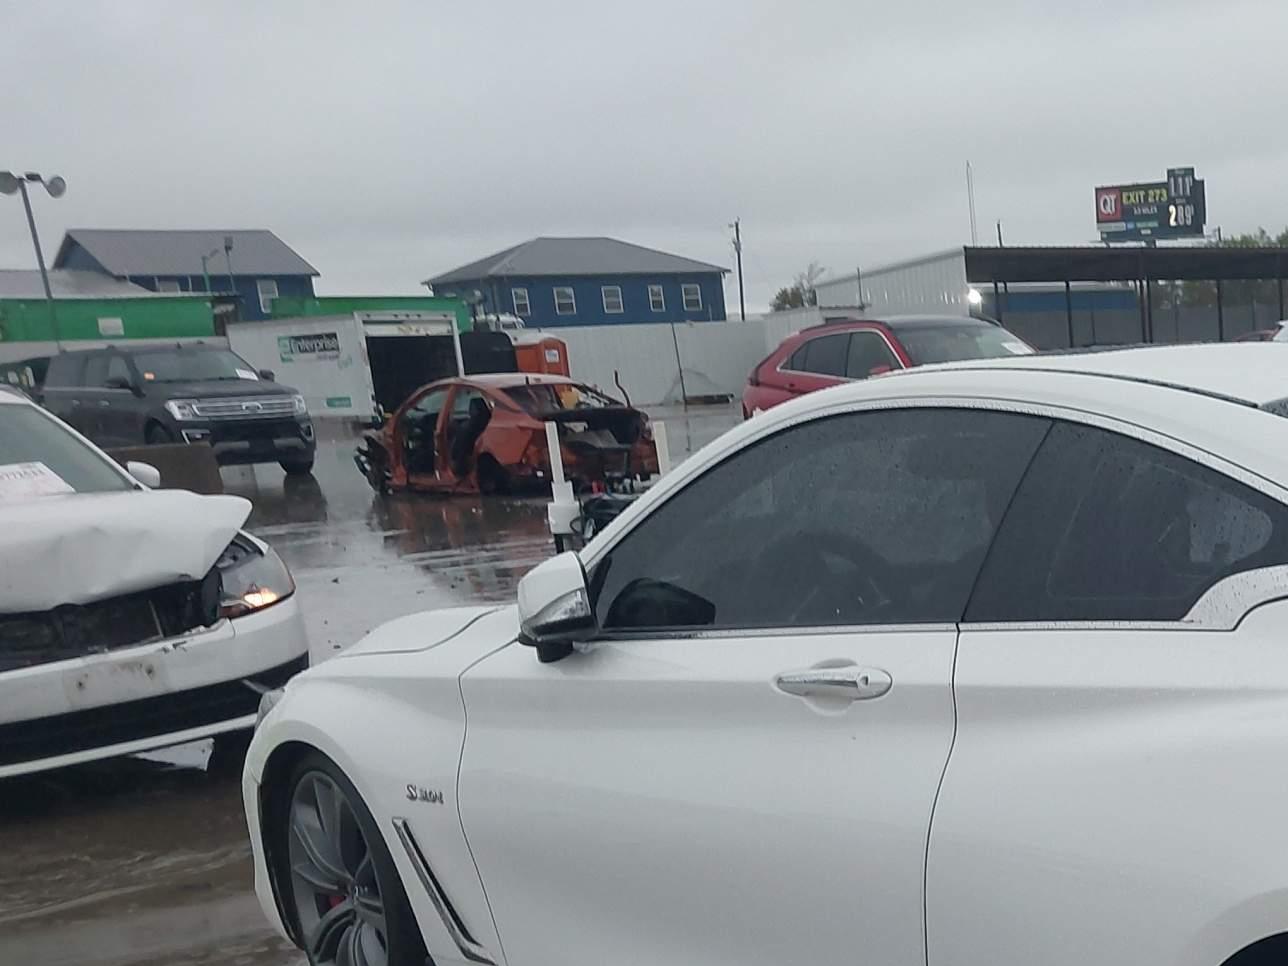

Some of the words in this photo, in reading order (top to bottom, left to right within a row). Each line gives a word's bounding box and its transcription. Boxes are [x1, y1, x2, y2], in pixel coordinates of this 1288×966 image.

[1100, 194, 1116, 215] QT
[1122, 191, 1145, 205] EXIT
[1147, 188, 1168, 203] 273
